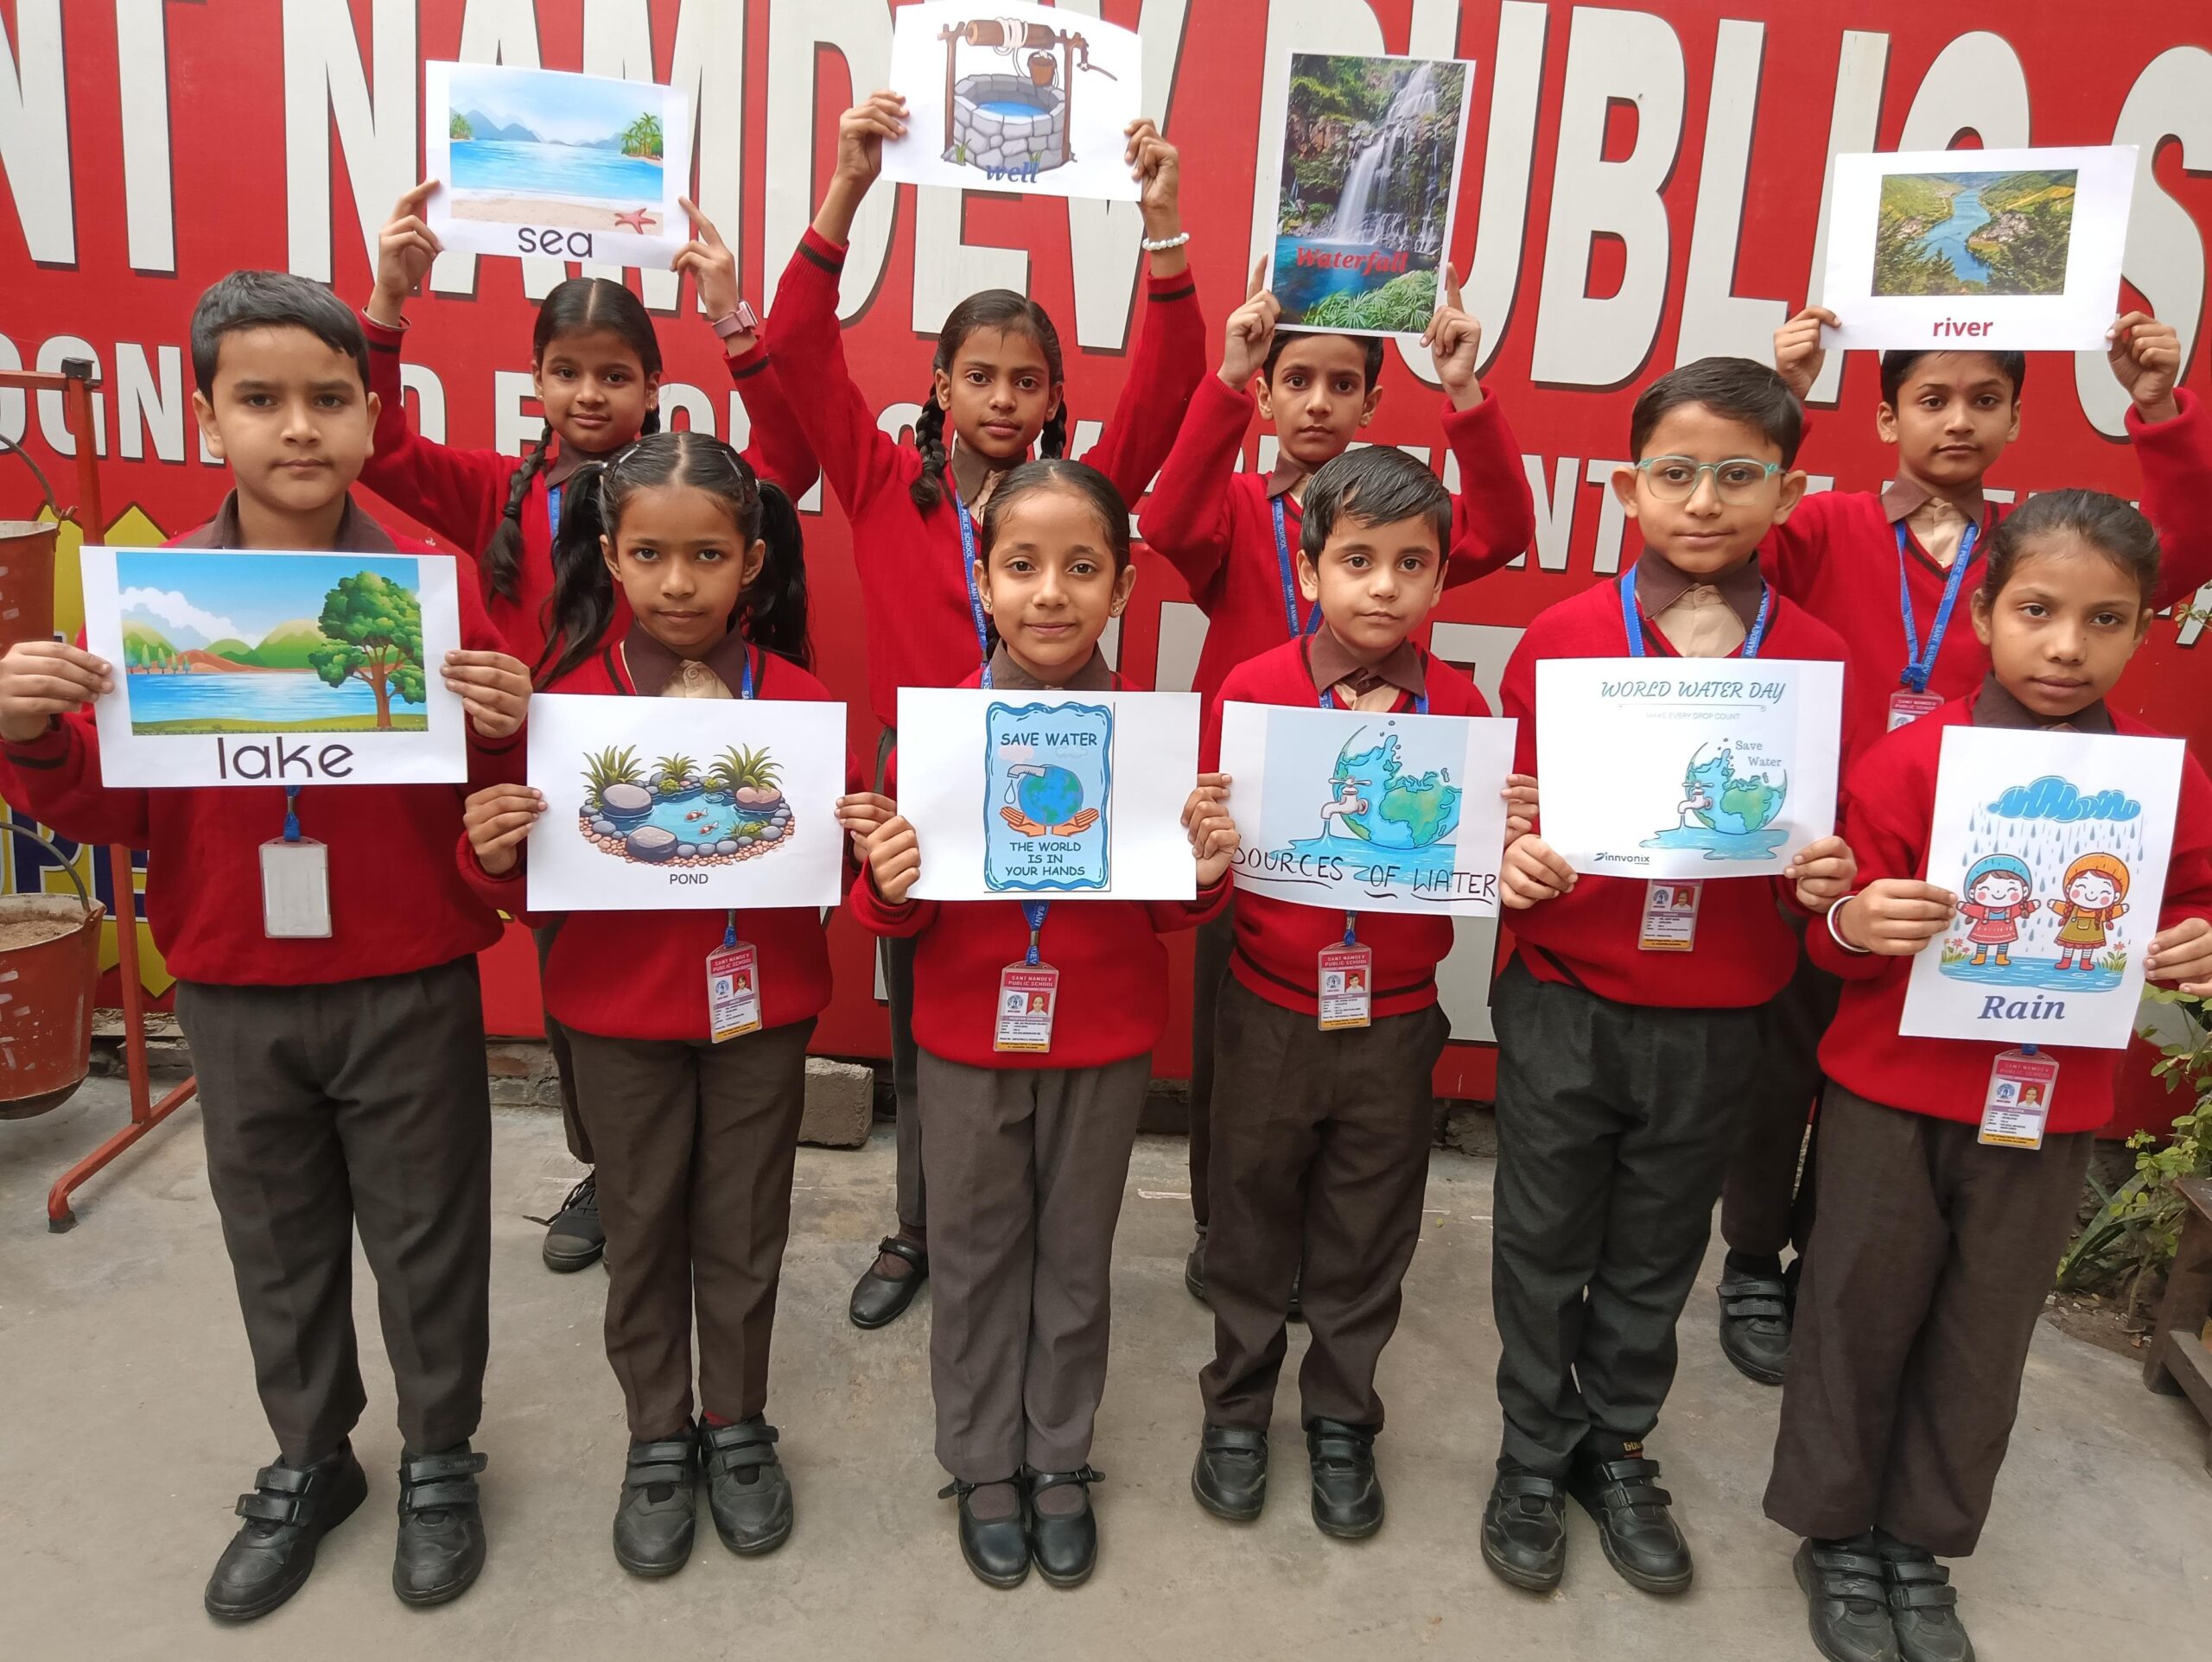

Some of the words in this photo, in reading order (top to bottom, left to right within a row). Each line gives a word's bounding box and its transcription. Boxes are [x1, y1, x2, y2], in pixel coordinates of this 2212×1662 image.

[986, 162, 1039, 183] well
[518, 225, 594, 259] sea
[1296, 246, 1408, 276] Waterfall
[1932, 315, 1994, 339] river
[1601, 681, 1672, 697] WORLD
[1678, 682, 1744, 698] WATER
[1749, 682, 1786, 704] DAY
[1001, 733, 1039, 745] SAVE
[1045, 733, 1097, 745] WATER
[1735, 740, 1763, 751] Save
[218, 736, 354, 780] lake
[1747, 756, 1782, 766] Water
[1009, 841, 1034, 852] THE
[1039, 842, 1082, 852] WORLD
[1027, 854, 1043, 864] IS
[1046, 854, 1063, 864] IN
[1605, 852, 1649, 862] innvonix
[670, 872, 709, 885] POND
[1005, 866, 1038, 876] YOUR
[1042, 866, 1085, 876] HANDS
[1370, 865, 1402, 887] OF
[1412, 868, 1497, 898] WATER
[1977, 994, 2065, 1020] Rain
